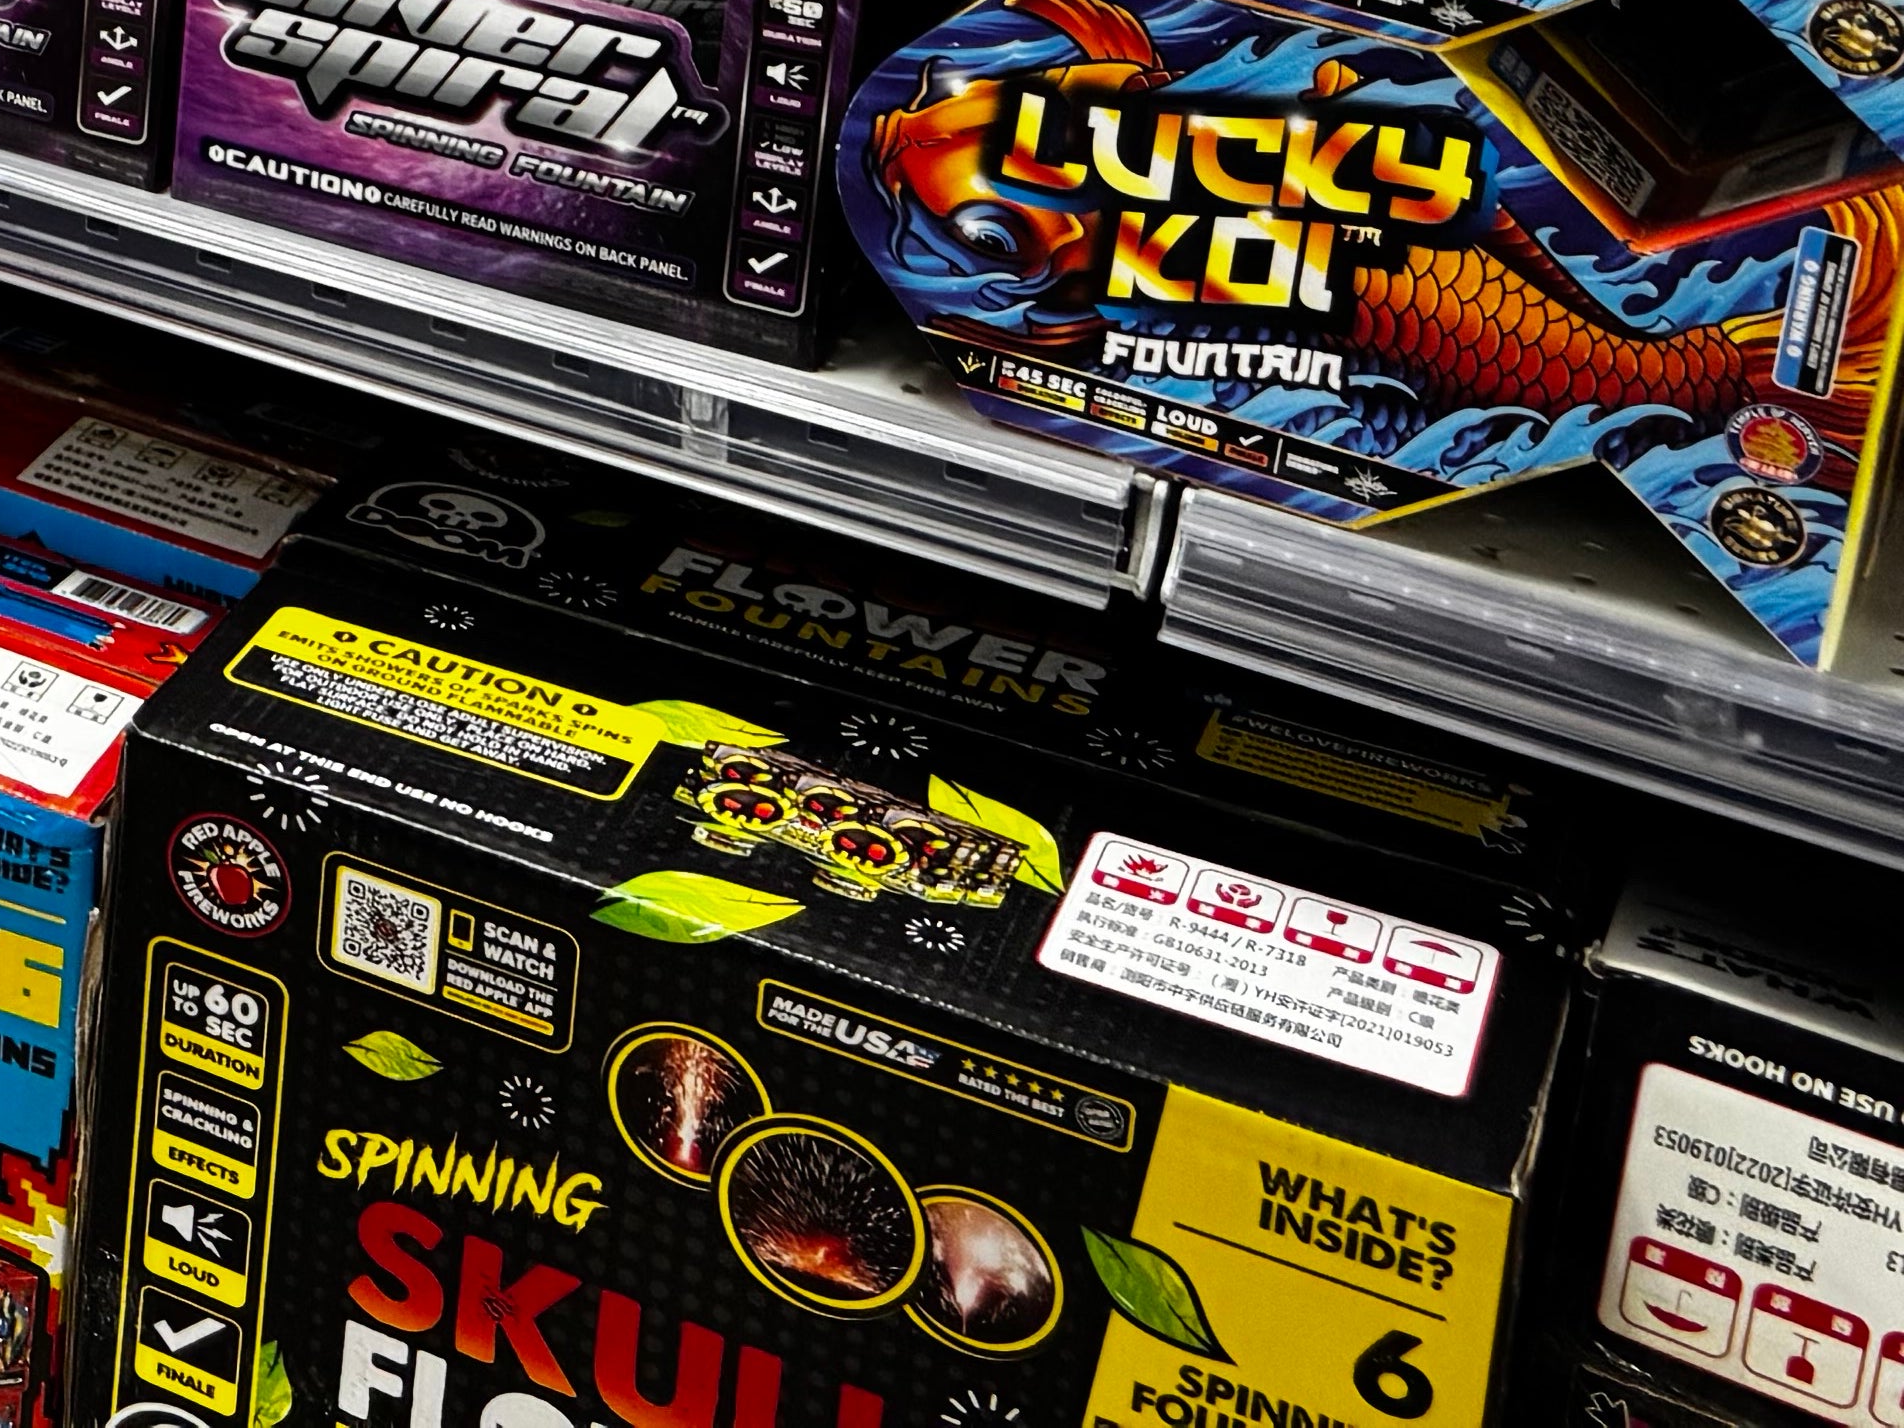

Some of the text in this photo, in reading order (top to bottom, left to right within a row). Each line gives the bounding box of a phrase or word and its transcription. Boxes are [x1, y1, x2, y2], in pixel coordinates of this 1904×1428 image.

[1001, 93, 1471, 224] LUCKY
[1107, 209, 1335, 311] KOI
[1103, 332, 1344, 390] FOUNTAIN
[278, 630, 633, 745] EMITS SHOWERS OF SPARKS SPINS
[368, 640, 563, 707] CAUTION
[483, 921, 558, 962] SCAN &
[483, 942, 556, 983] WATCH
[1153, 932, 1268, 977] GB10631-2013
[1169, 916, 1308, 968] R-9444 R-7318
[173, 979, 260, 1022] UP 60
[174, 997, 253, 1050] TO SEC
[773, 996, 836, 1029] MADE
[164, 1032, 261, 1082] DURATION
[834, 1019, 916, 1067] USA
[958, 1073, 1065, 1118] RATED THE BEST
[1688, 1036, 1895, 1123] USE NO HOOKS
[317, 1128, 610, 1233] SPINNING
[1259, 1160, 1457, 1257] WHAT'S
[1259, 1197, 1454, 1291] INSIDE?
[168, 1255, 221, 1290] LOUD
[156, 1360, 216, 1400] FINALE
[1353, 1329, 1434, 1420] 6
